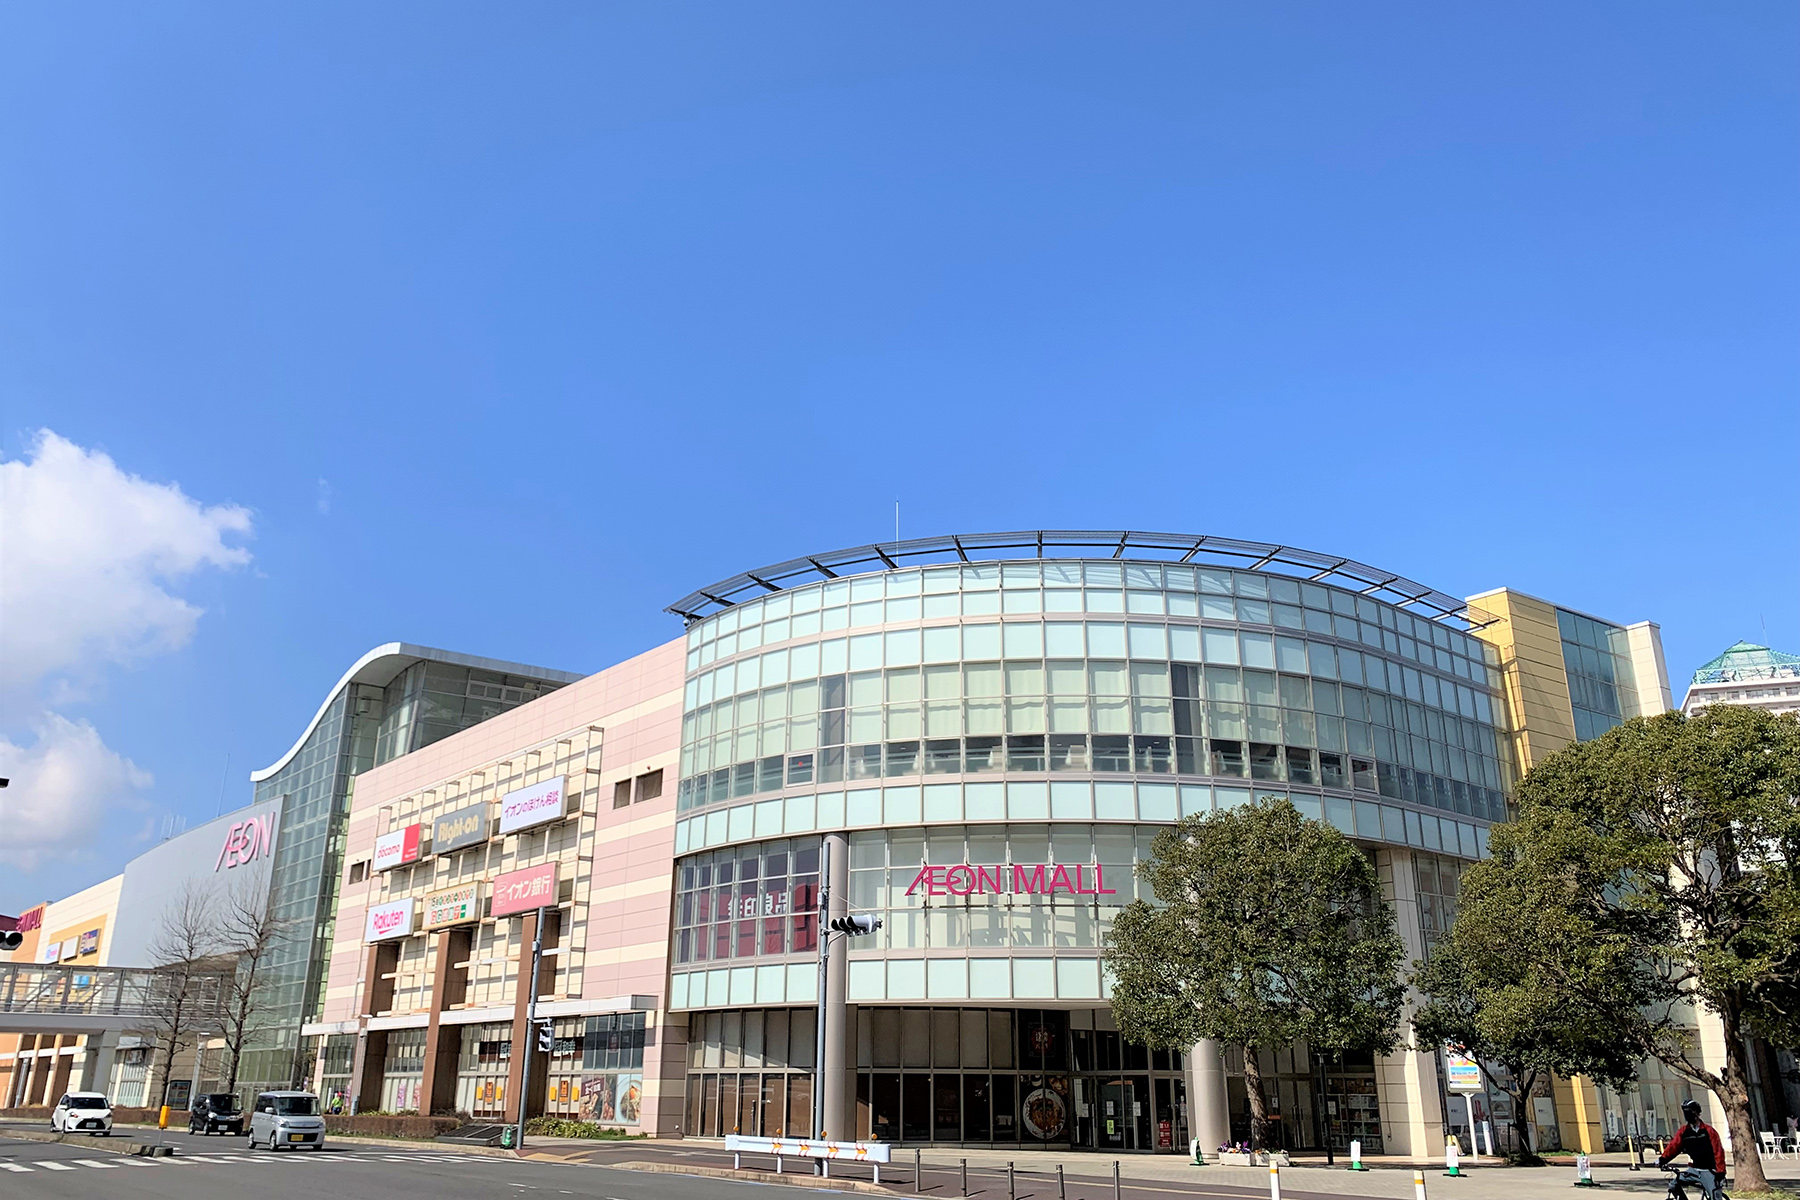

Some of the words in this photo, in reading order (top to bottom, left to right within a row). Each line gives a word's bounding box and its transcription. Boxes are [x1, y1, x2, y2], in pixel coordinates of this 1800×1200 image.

[377, 844, 401, 859] docomo
[506, 874, 551, 901] イオン銀行
[1013, 863, 1117, 896] MALL
[373, 908, 404, 930] Rakuten
